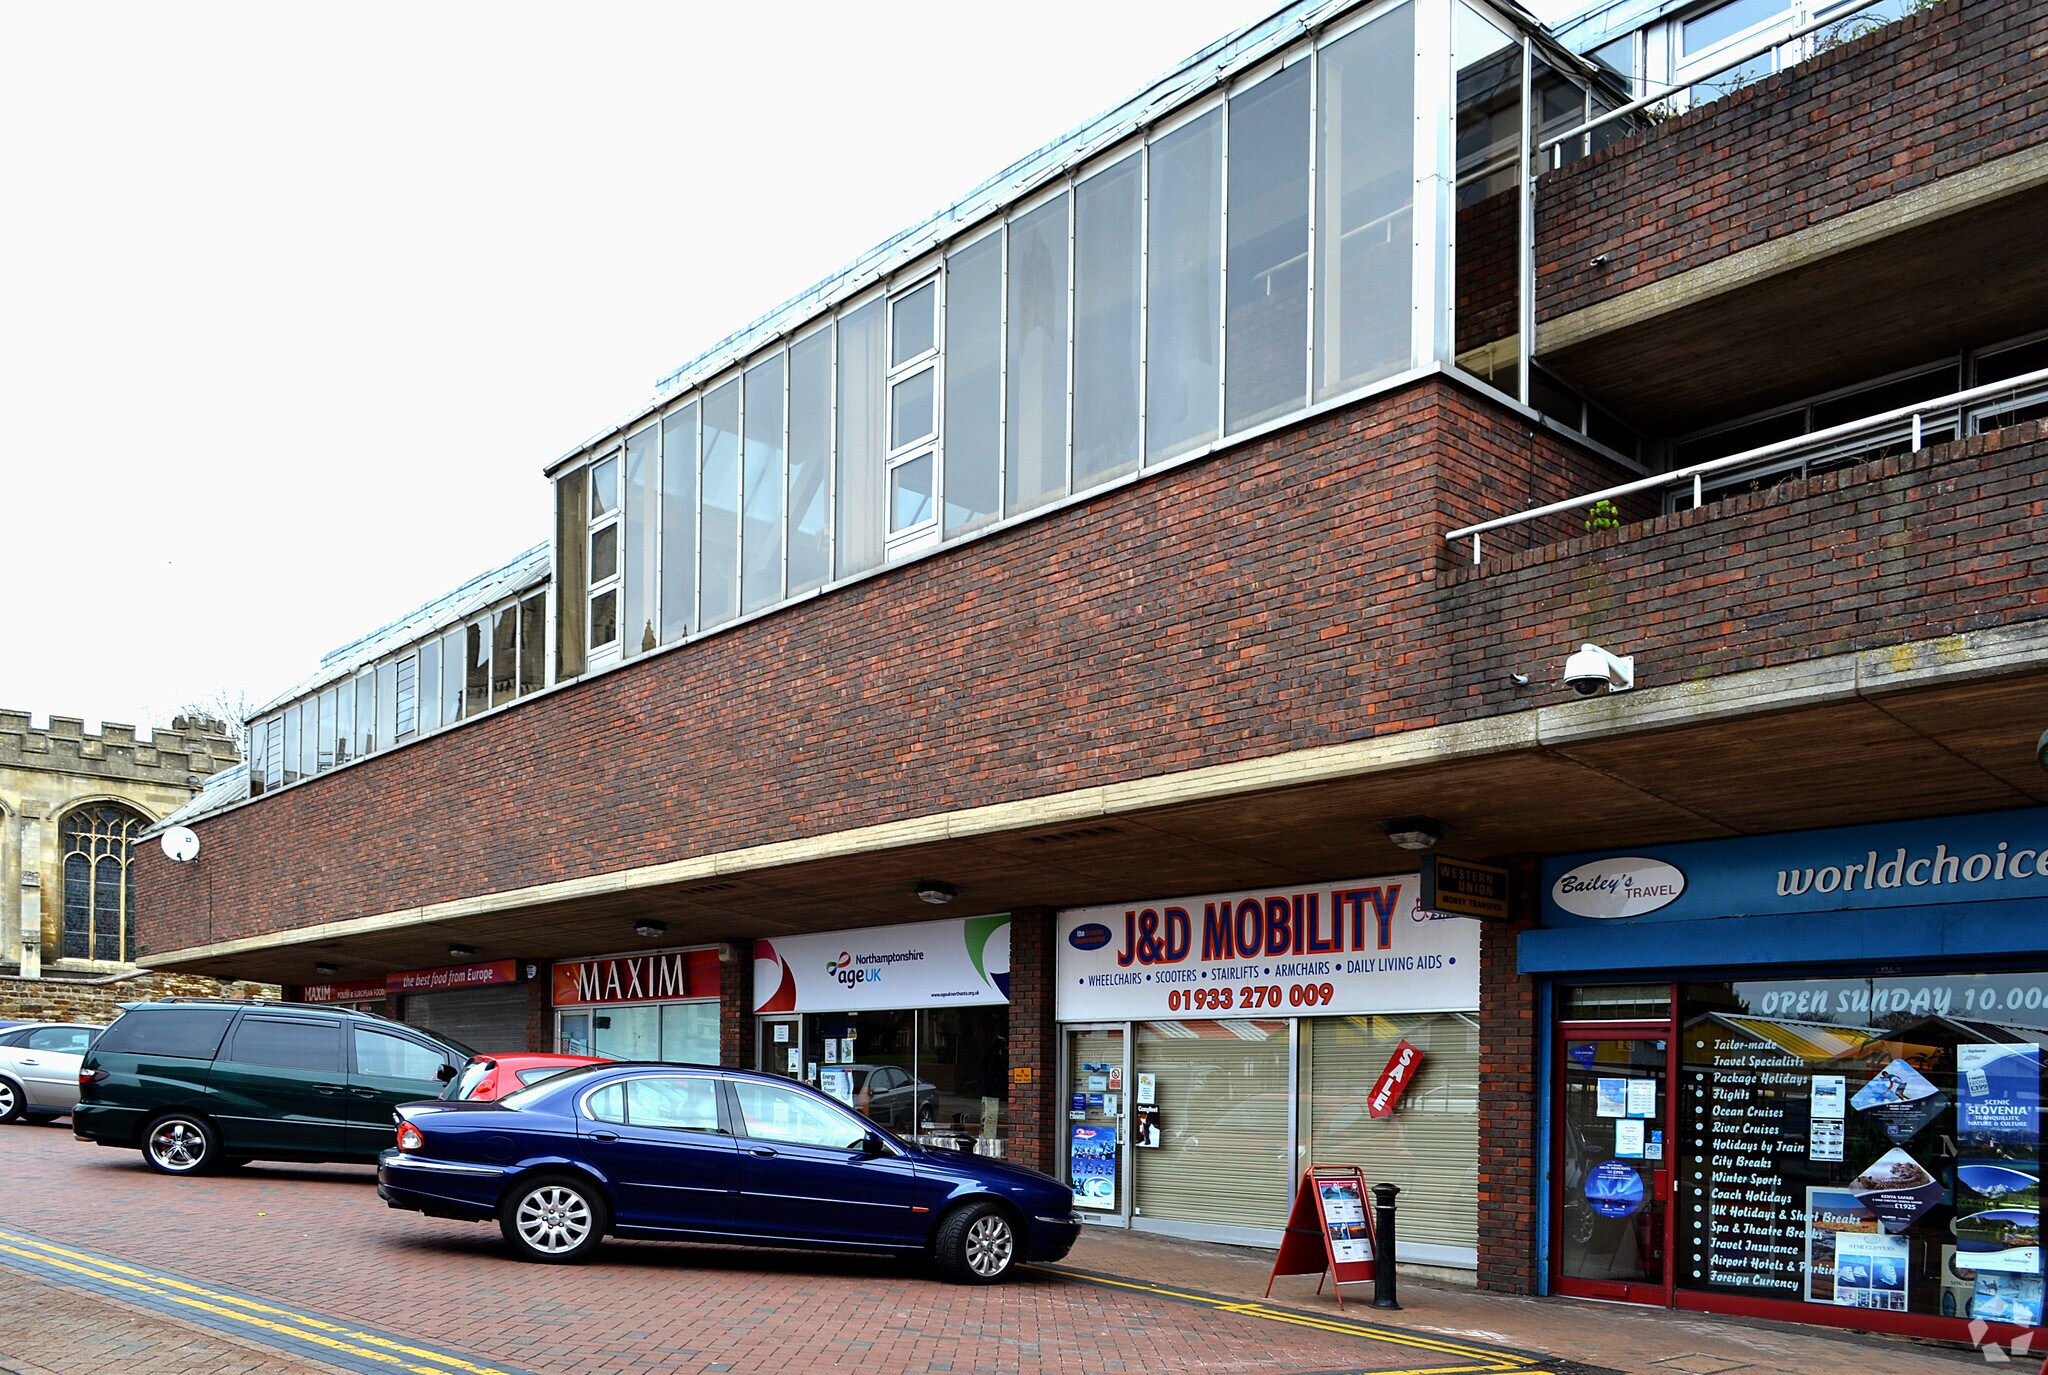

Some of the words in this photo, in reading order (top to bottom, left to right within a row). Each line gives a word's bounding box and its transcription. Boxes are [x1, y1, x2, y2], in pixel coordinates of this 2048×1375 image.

[1440, 866, 1494, 884] WESTERN
[1776, 842, 2048, 896] worldchoice
[1459, 881, 1494, 896] UNION
[1561, 874, 1633, 894] Bailey's
[1625, 885, 1676, 899] TRAVEL
[1443, 895, 1466, 906] MONEY
[1469, 899, 1503, 912] TRANSFER
[1118, 906, 1192, 968] J&D
[1201, 884, 1402, 961] MOBILITY
[856, 950, 924, 965] Northamptonshire
[403, 975, 414, 987] the
[415, 974, 431, 986] best
[430, 970, 447, 988] food
[447, 970, 466, 986] from
[467, 968, 494, 983] Europe
[578, 954, 684, 1001] MAXIM
[1088, 973, 1142, 987] WHEELCHAIRS
[1156, 969, 1197, 983] SCOOTERS
[1211, 966, 1260, 981] STAIRLIFTS
[1274, 962, 1330, 977] ARMCHAIRS
[1347, 959, 1376, 974] DAILY
[1379, 957, 1414, 972] LIVING
[1416, 955, 1443, 970] AIDS
[304, 985, 331, 1002] MAXIM
[374, 988, 385, 997] FOOD
[1168, 987, 1233, 1011] 01933
[1239, 985, 1282, 1008] 270
[1289, 982, 1334, 1007] 009
[1761, 989, 1828, 1014] OPEN
[1836, 987, 1952, 1016] SUNDAY
[1714, 1039, 1777, 1050] Tailor-made
[1713, 1056, 1746, 1066] Travel
[1748, 1055, 1804, 1068] Specialists
[1373, 1048, 1414, 1111] SALE
[1713, 1072, 1757, 1085] Package
[1761, 1072, 1808, 1086] Holidays
[1712, 1088, 1750, 1102] Flights
[1712, 1105, 1744, 1116] Ocean
[1747, 1106, 1783, 1117] Cruises
[1968, 1106, 2028, 1115] SLOVENIA
[1712, 1121, 1740, 1133] River
[1742, 1123, 1779, 1134] Cruises
[1712, 1139, 1758, 1152] Holidays
[1761, 1140, 1773, 1153] by
[1776, 1141, 1804, 1152] Train
[1712, 1155, 1733, 1168] City
[1736, 1155, 1772, 1168] Breaks
[1712, 1171, 1747, 1183] Winter
[1750, 1173, 1782, 1186] Sports
[1711, 1188, 1741, 1199] Coach
[1745, 1190, 1792, 1205] Holidays
[1711, 1205, 1726, 1216] UK
[1729, 1206, 1776, 1221] Holidays
[1779, 1210, 1787, 1220] &
[1822, 1211, 1861, 1224] Breaks
[1710, 1221, 1729, 1233] Spa
[1732, 1223, 1740, 1233] &
[1743, 1223, 1782, 1237] Theatre
[1710, 1237, 1742, 1250] Travel
[1745, 1240, 1799, 1255] Insurance
[1710, 1254, 1748, 1269] Airport
[1750, 1257, 1783, 1271] Hotels
[1786, 1261, 1796, 1272] &
[1710, 1270, 1750, 1286] Foreign
[1752, 1274, 1799, 1291] Currency
